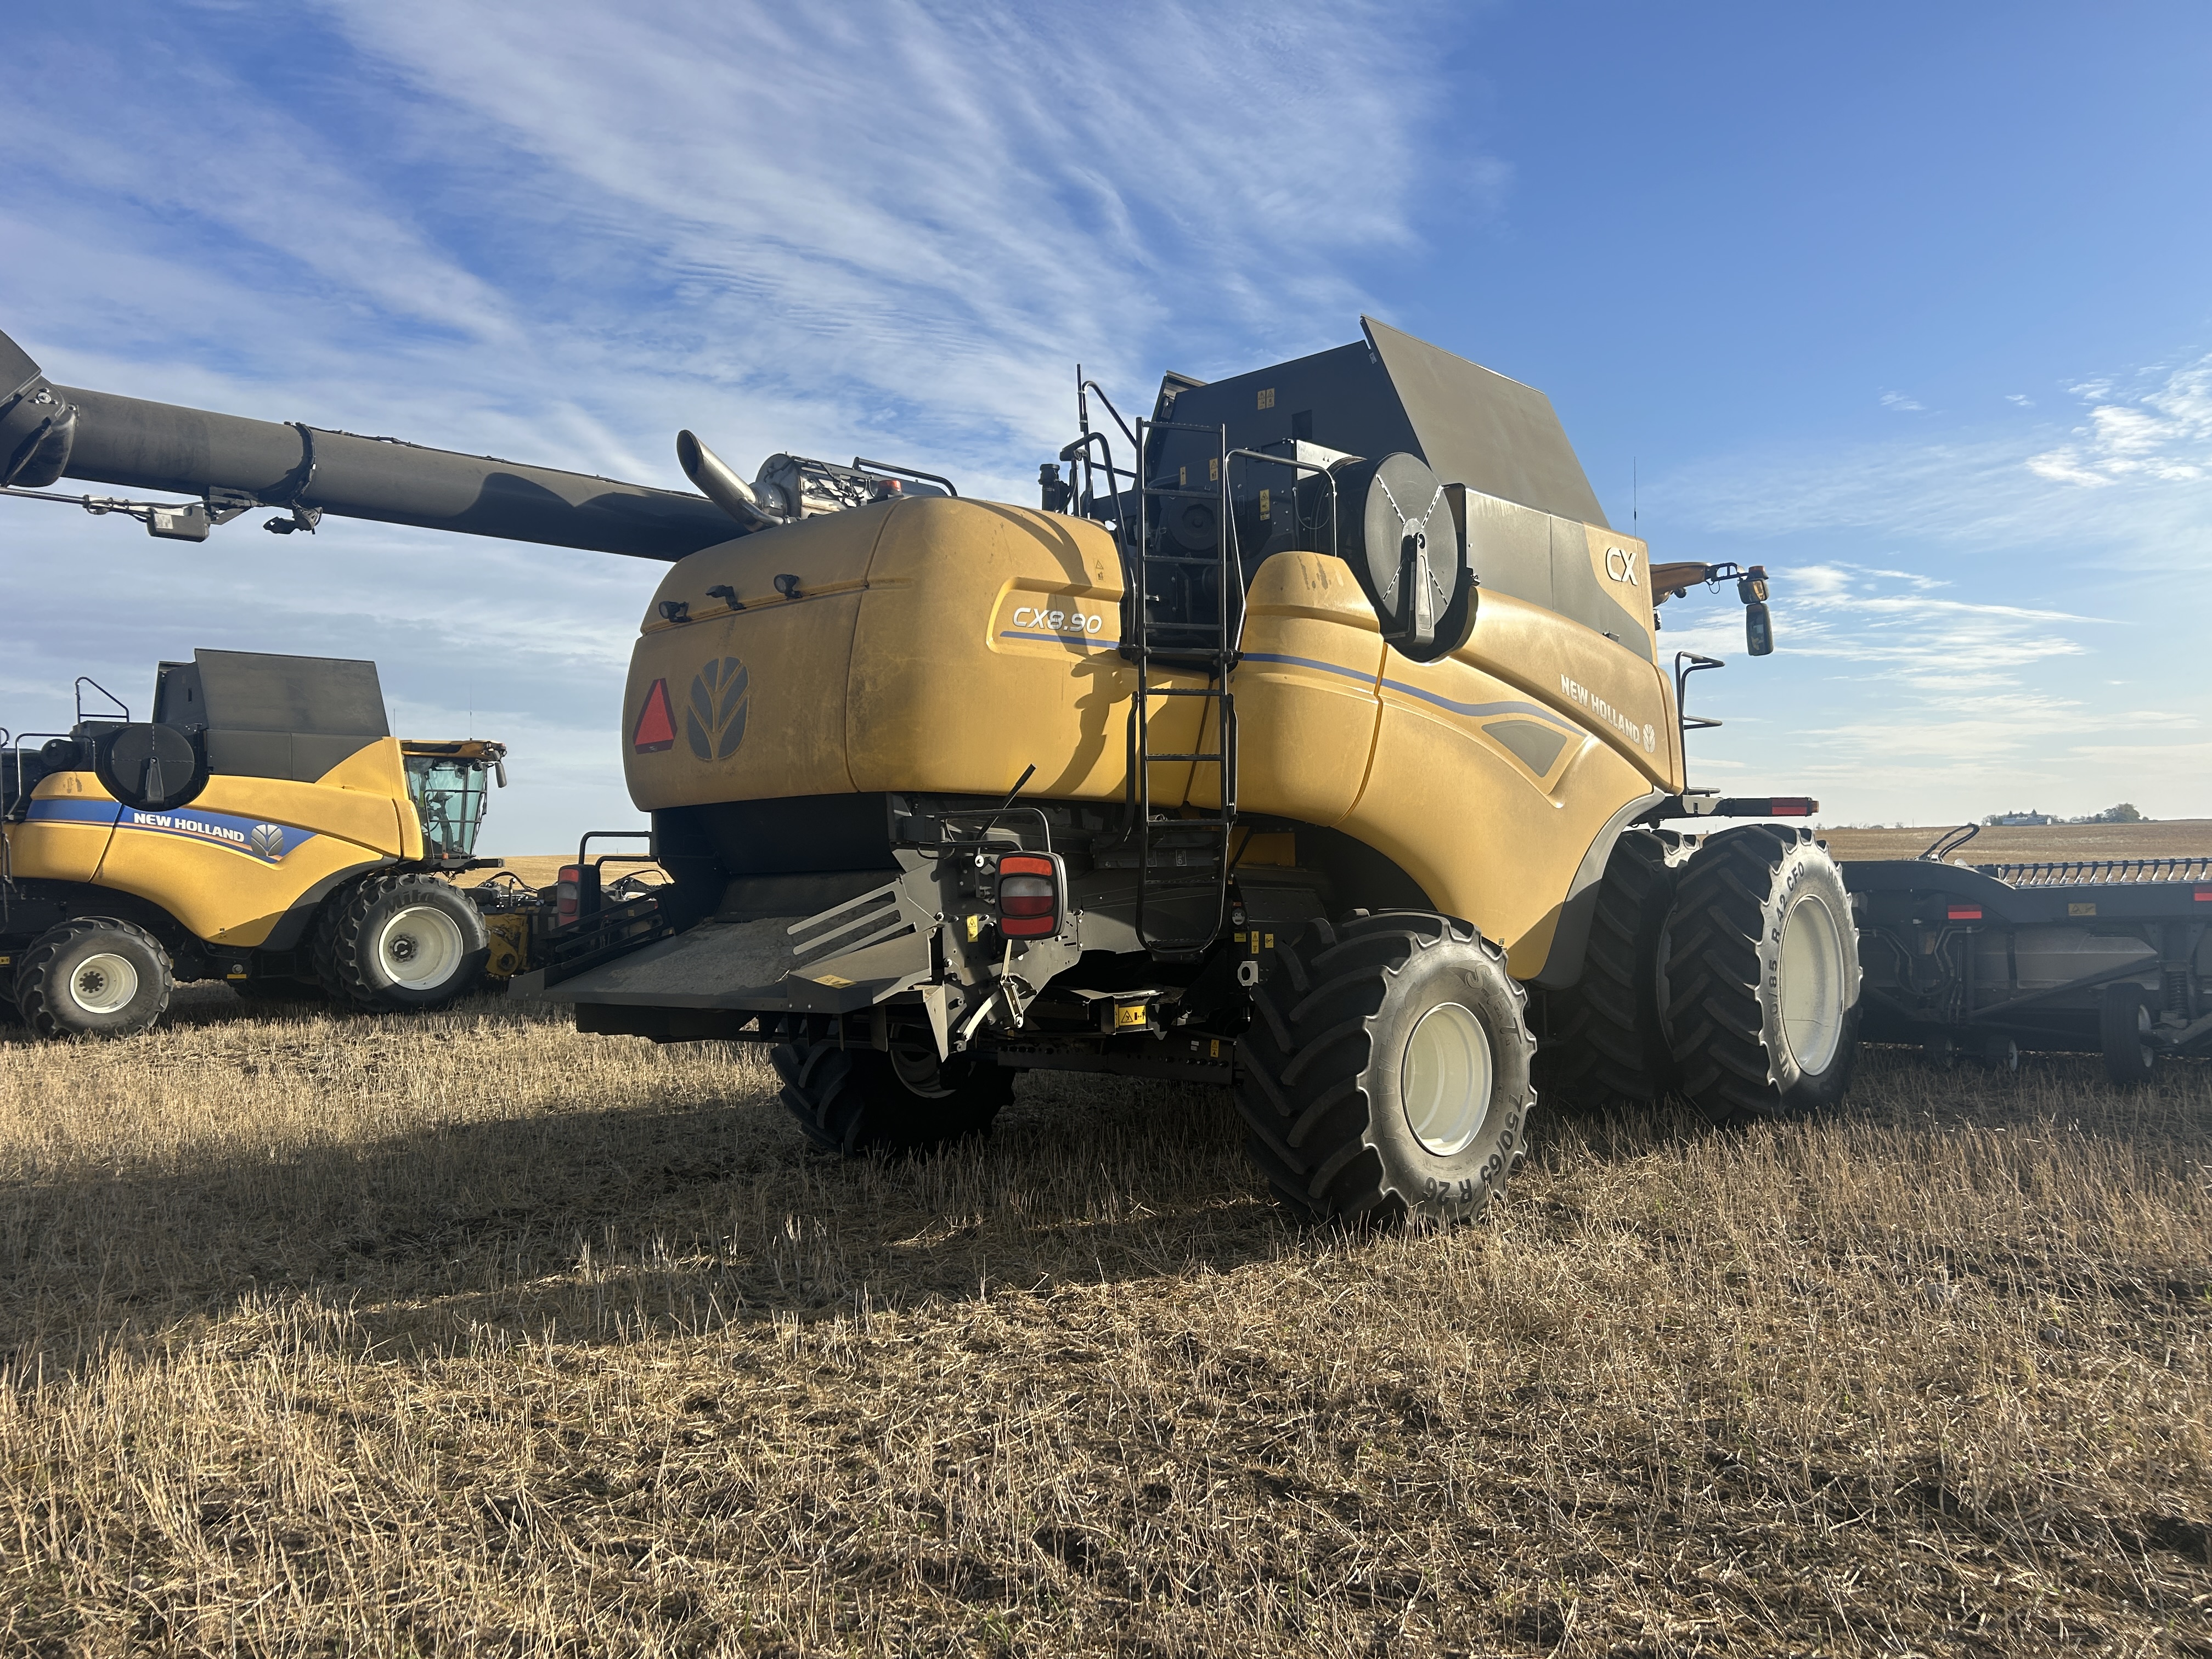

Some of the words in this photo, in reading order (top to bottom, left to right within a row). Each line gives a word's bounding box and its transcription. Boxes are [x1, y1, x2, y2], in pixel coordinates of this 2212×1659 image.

[1605, 547, 1638, 586] CX
[1013, 607, 1102, 634] CX8.90
[1560, 674, 1588, 708] NEW
[1590, 693, 1640, 744] HOLLAND
[134, 812, 172, 827] NEW
[174, 817, 245, 843] HOLLAND
[1786, 861, 1804, 891] CFO
[1776, 894, 1788, 923] 42
[1771, 927, 1781, 944] R
[1778, 1050, 1790, 1079] VF
[1480, 1094, 1523, 1188] 750/65
[1422, 1176, 1451, 1206] 26
[1458, 1178, 1472, 1204] R
